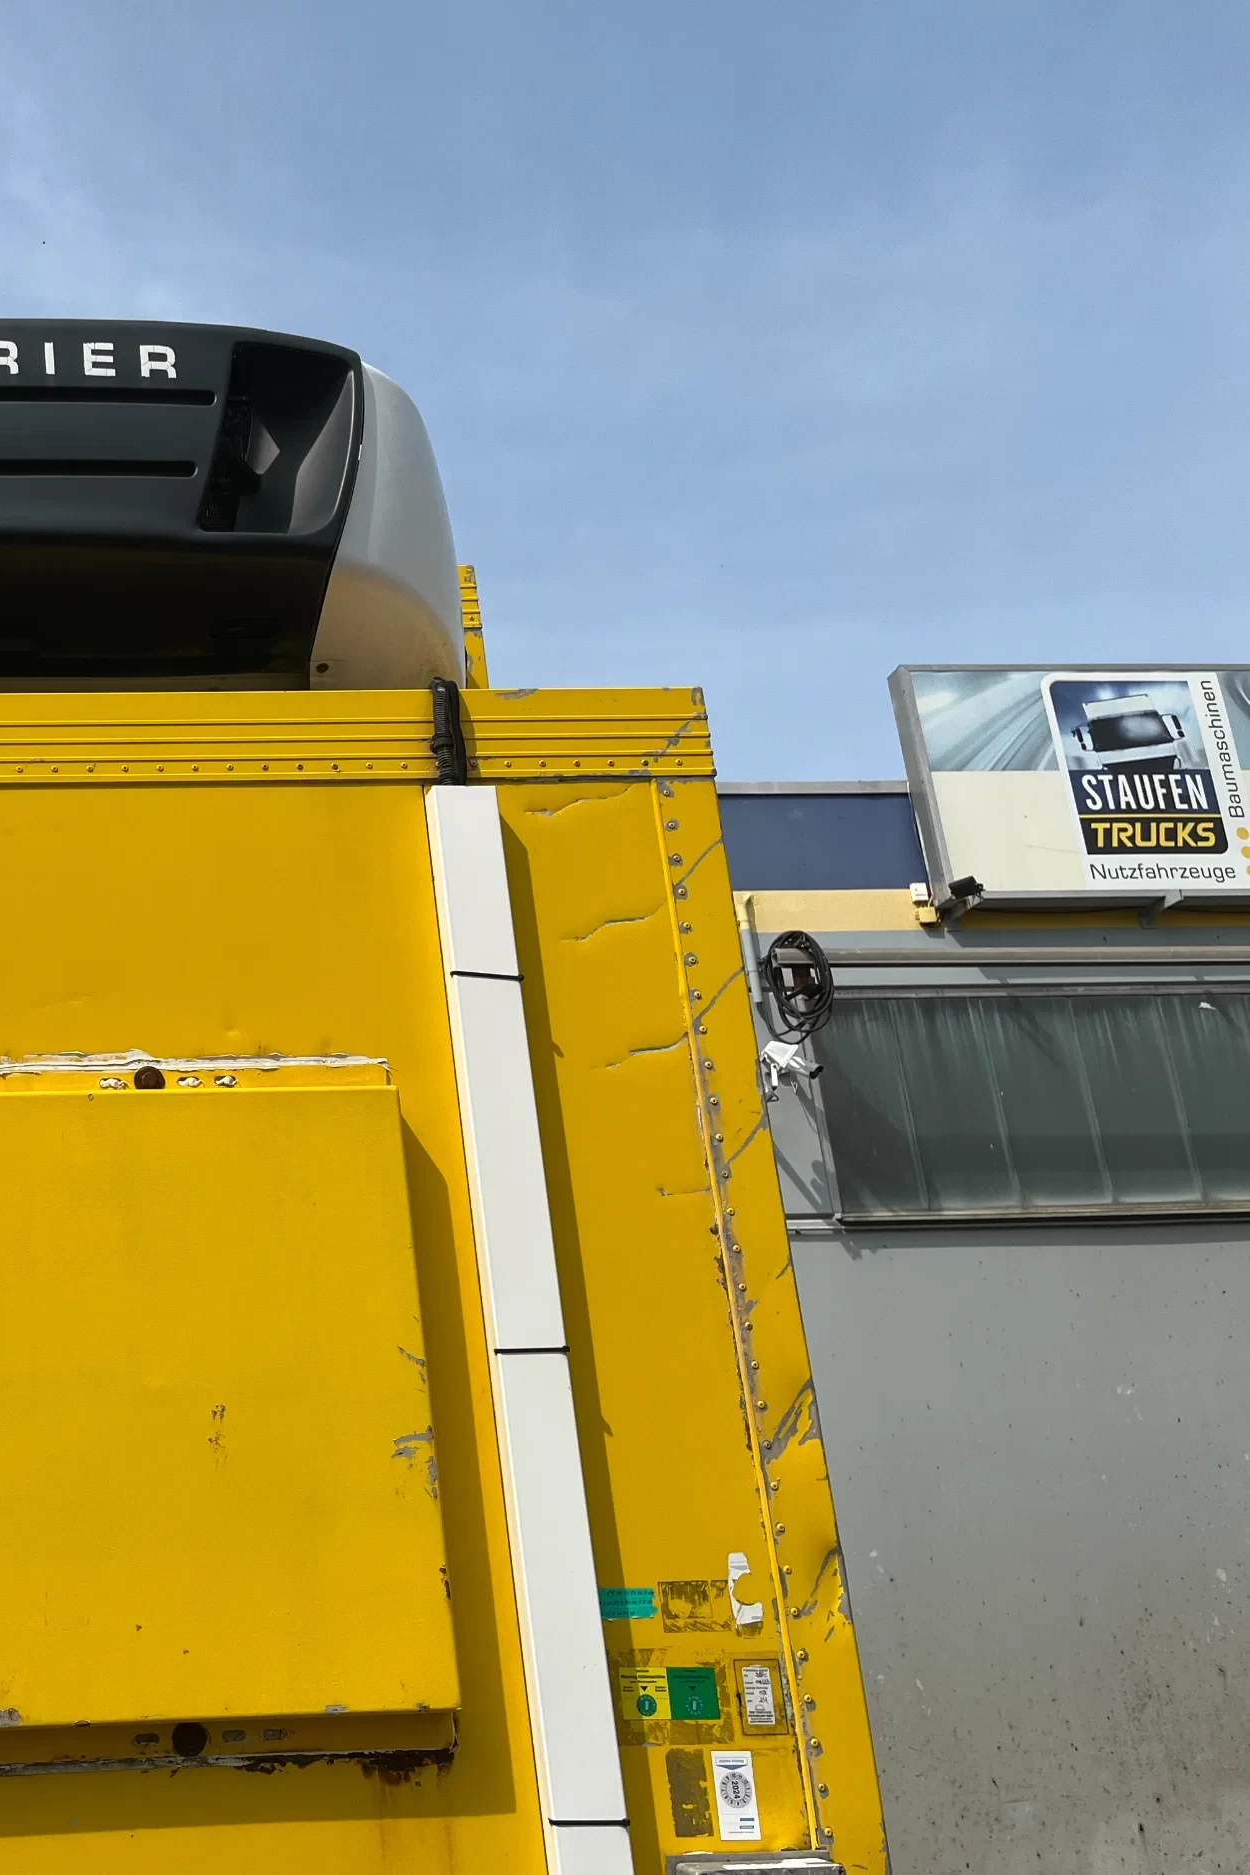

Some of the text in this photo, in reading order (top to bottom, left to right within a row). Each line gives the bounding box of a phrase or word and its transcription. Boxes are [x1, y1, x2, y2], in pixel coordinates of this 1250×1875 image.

[1200, 680, 1245, 818] Baumaschinen
[1081, 774, 1209, 810] STAUFEN
[1091, 822, 1216, 848] TRUCKS
[1089, 863, 1237, 883] Nutzfahrzeuge
[731, 1780, 741, 1800] 2024
